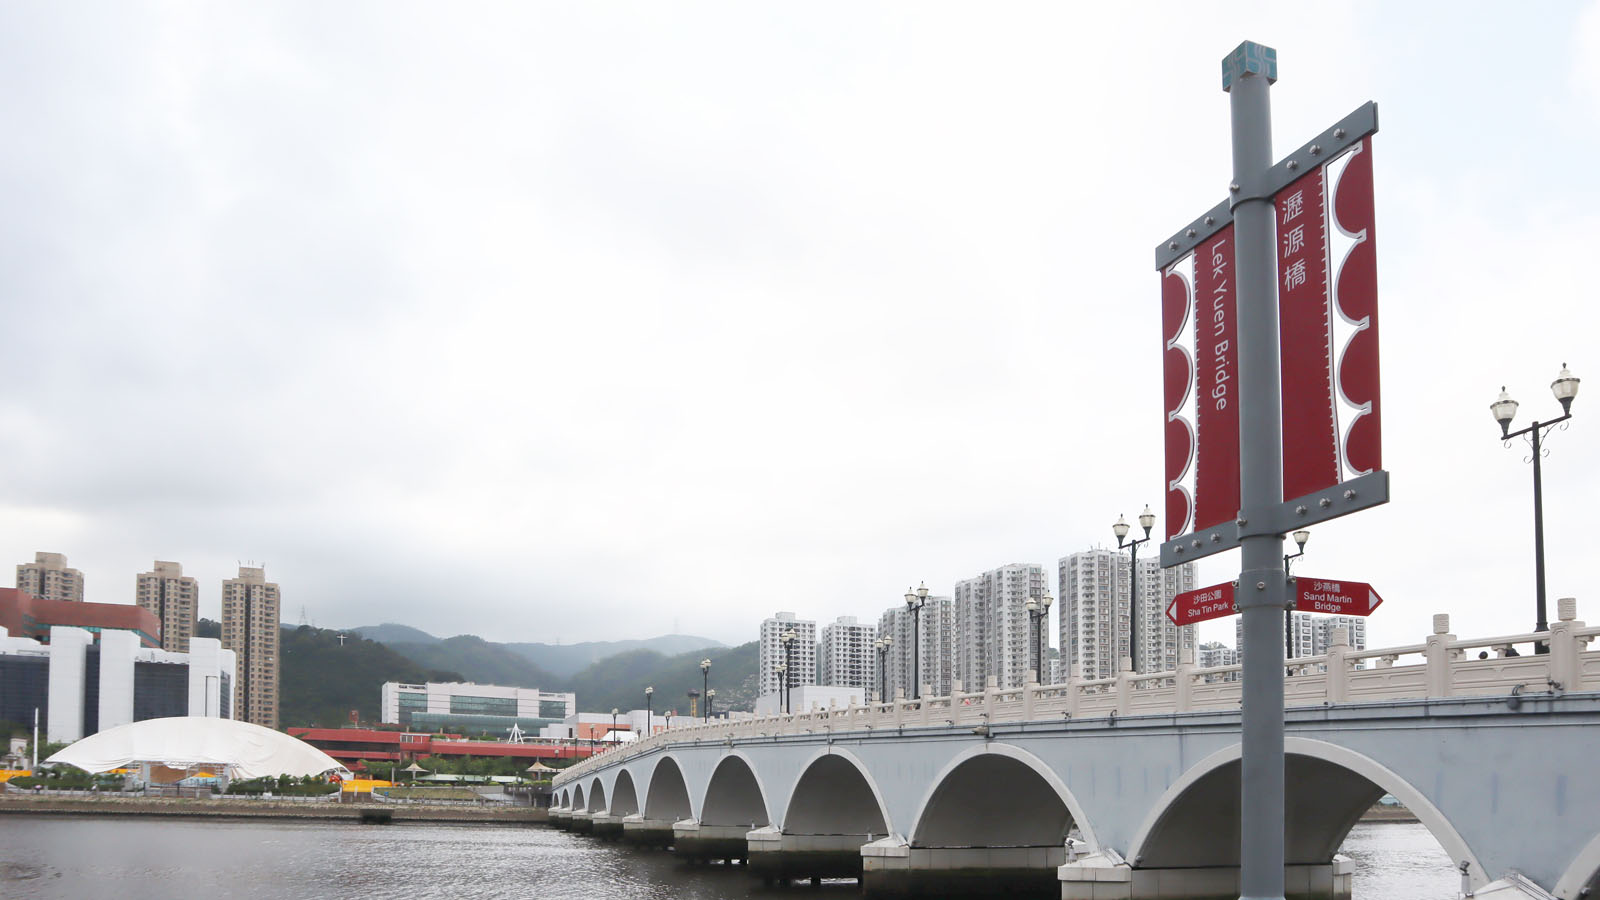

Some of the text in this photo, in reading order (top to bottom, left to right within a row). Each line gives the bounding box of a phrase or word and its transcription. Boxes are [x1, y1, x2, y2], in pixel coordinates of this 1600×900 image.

[1282, 189, 1306, 292] 瀝源橋
[1212, 239, 1231, 411] Lek Yuen Bridge
[1303, 591, 1353, 604] Sand Martin
[1187, 601, 1229, 618] Sha Tin Park
[1314, 601, 1342, 613] Bridge
